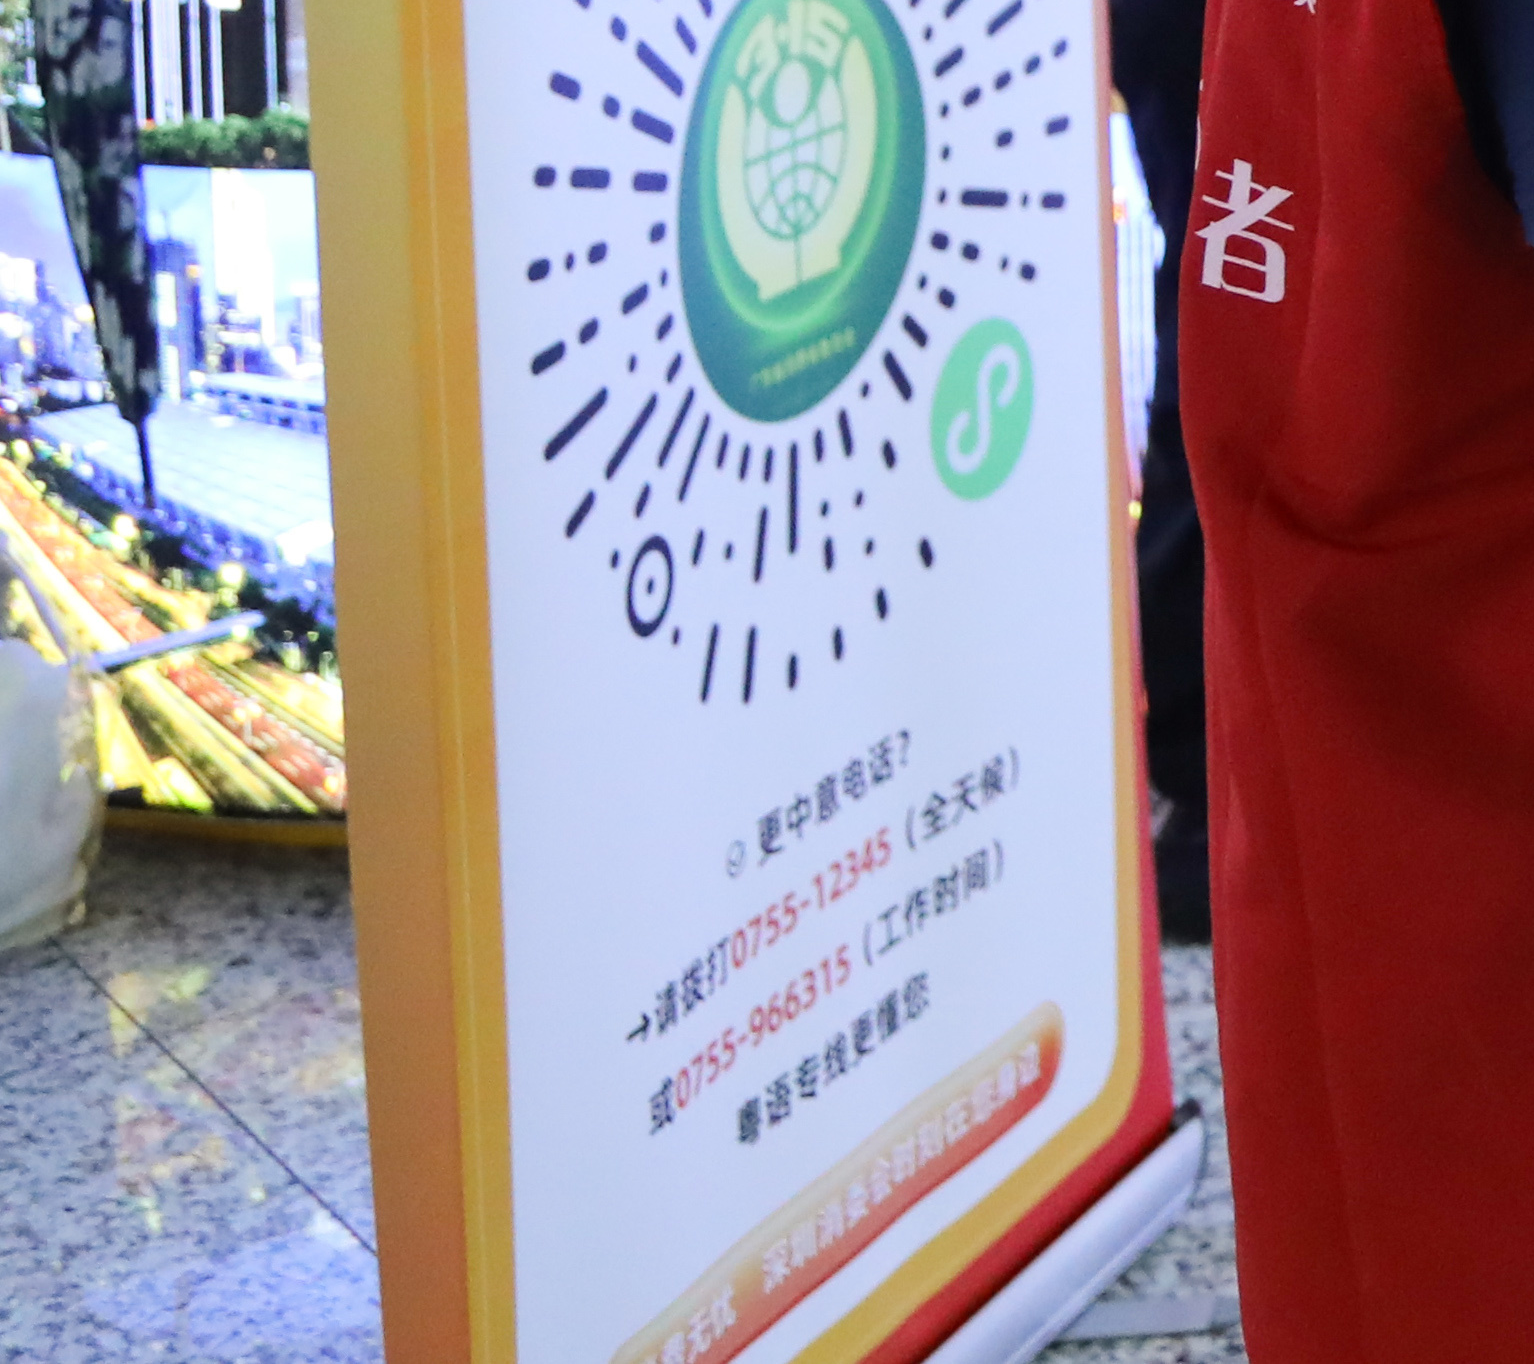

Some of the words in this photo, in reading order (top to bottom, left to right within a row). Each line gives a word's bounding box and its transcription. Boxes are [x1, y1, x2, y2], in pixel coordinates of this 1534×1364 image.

[735, 971, 932, 1147] 粤语专线更懂您
